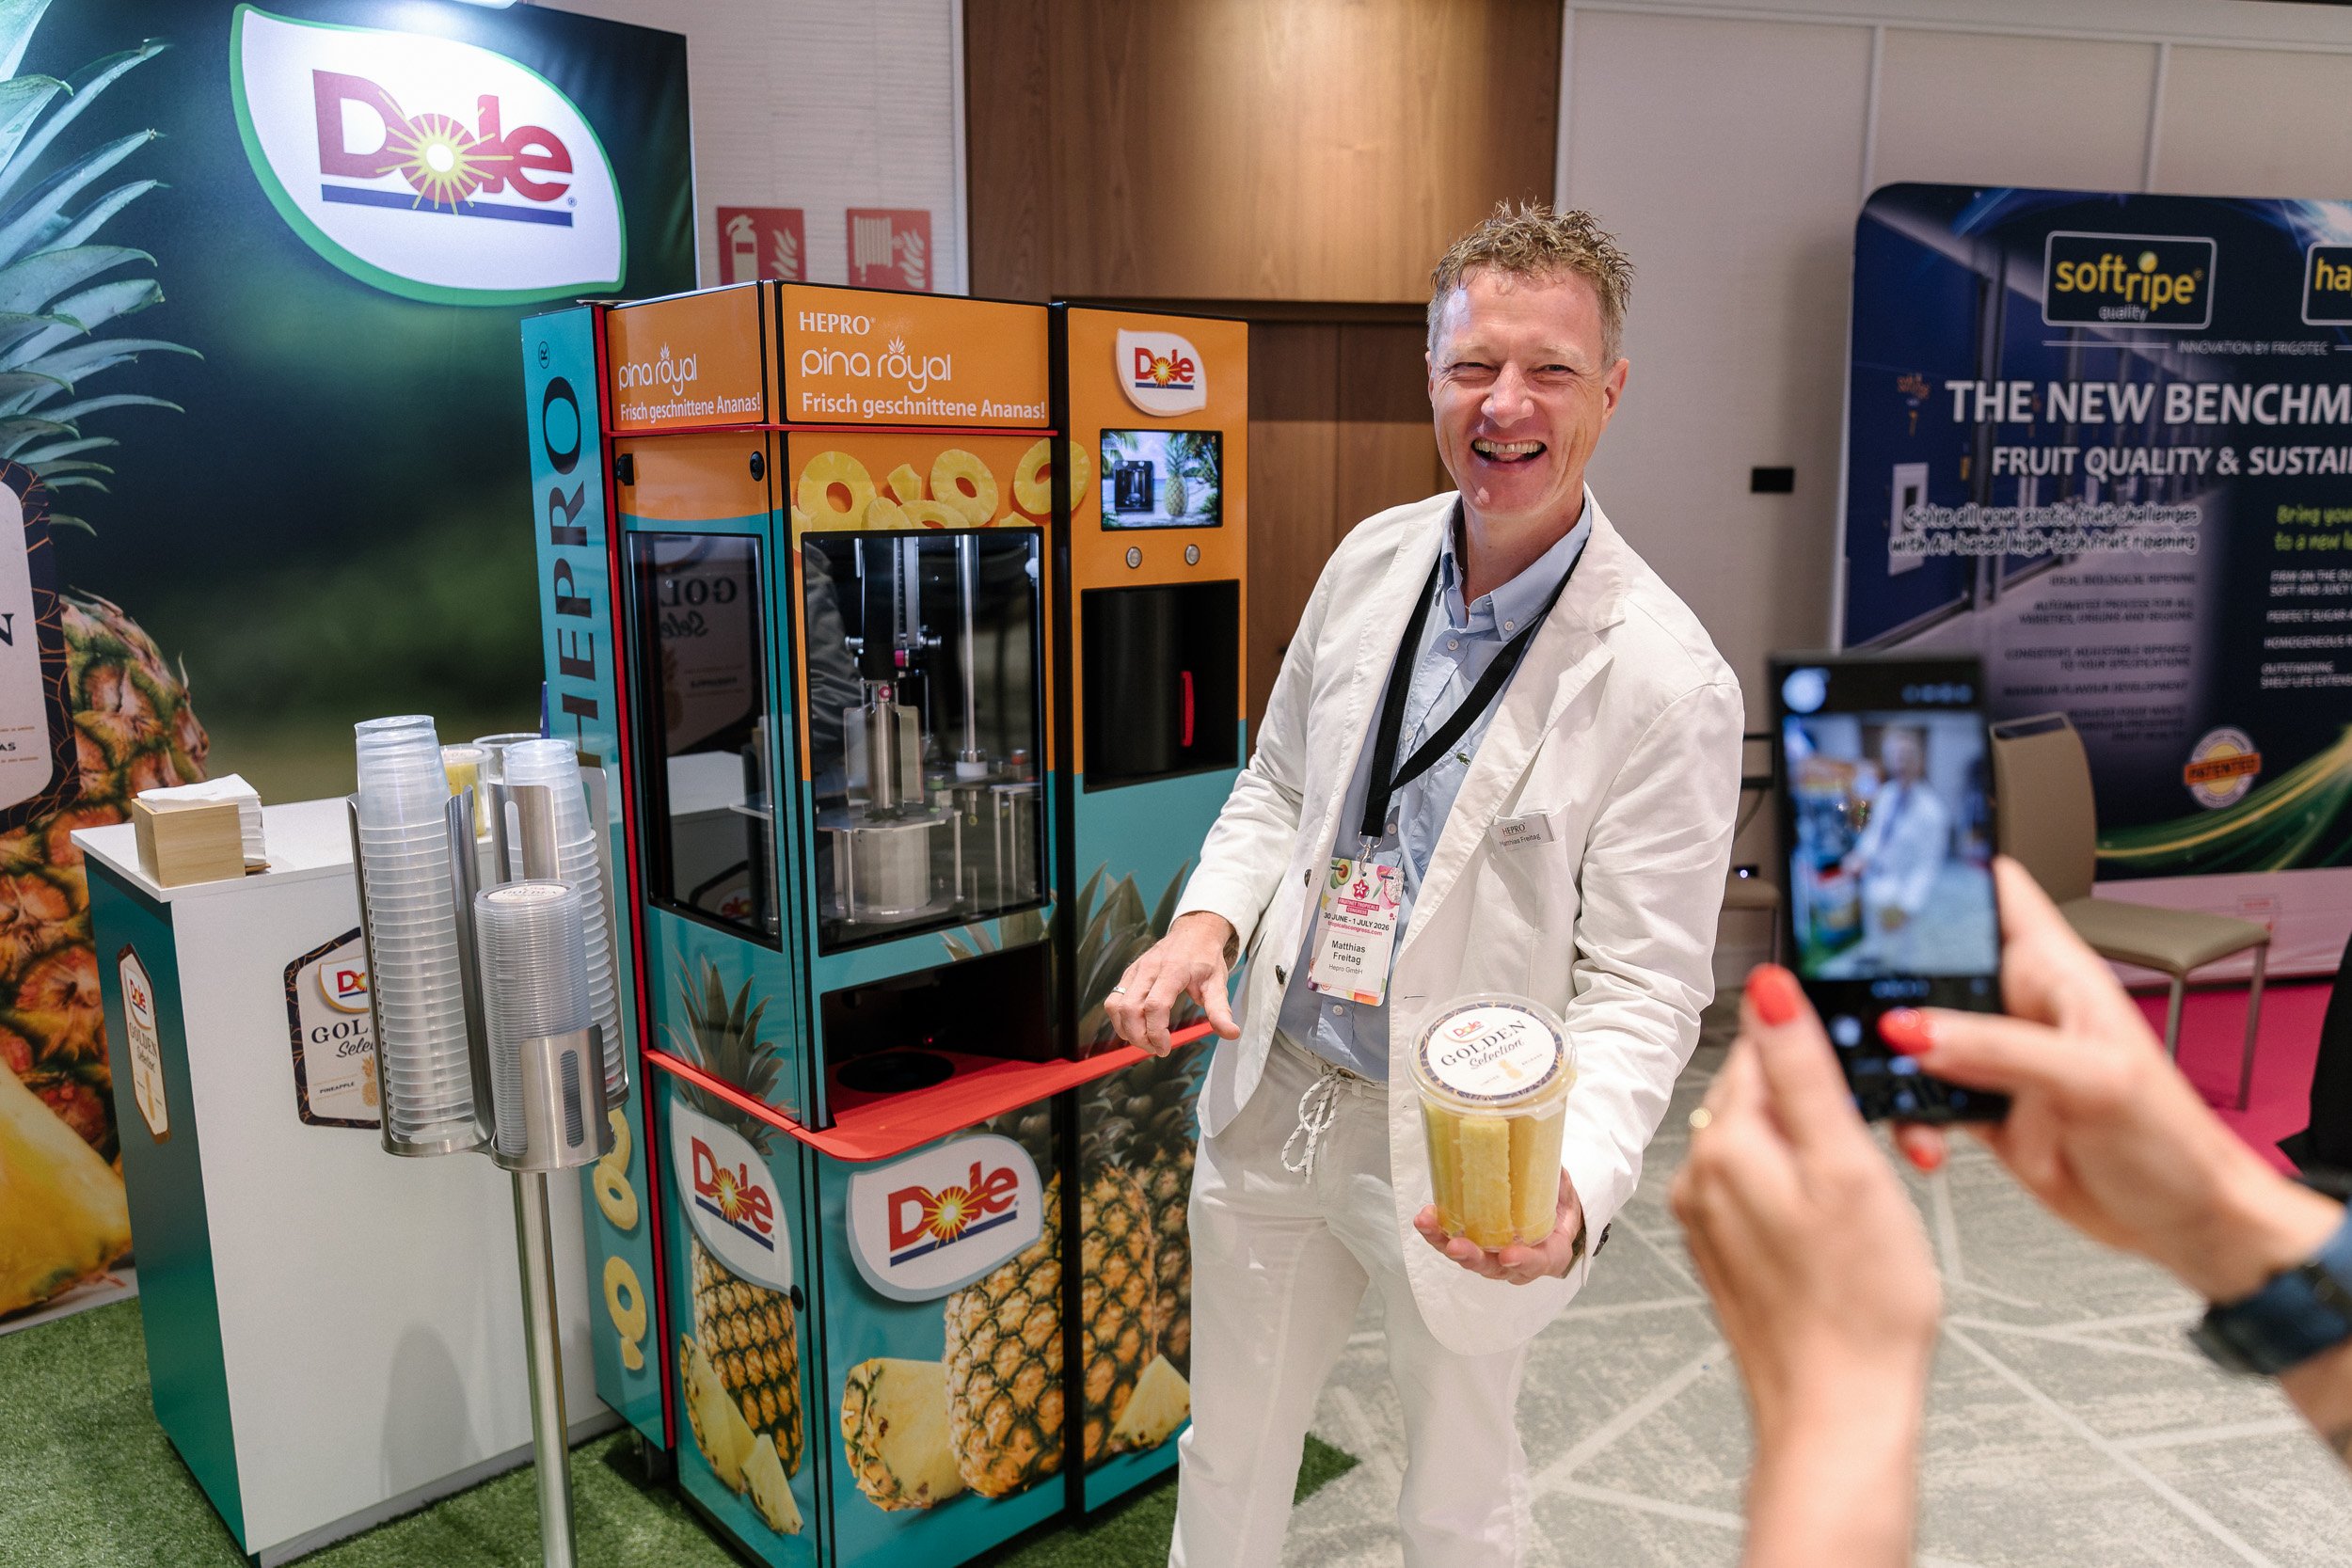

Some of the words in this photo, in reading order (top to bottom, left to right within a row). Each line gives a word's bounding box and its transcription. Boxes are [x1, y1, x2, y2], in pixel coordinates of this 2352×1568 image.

[2055, 251, 2196, 311] softripe
[2098, 304, 2149, 323] quality
[618, 362, 653, 391] pina
[655, 353, 697, 396] royal
[800, 347, 870, 378] pina
[877, 353, 951, 394] royal
[1135, 347, 1195, 385] Dole
[620, 402, 648, 421] Frisch
[649, 398, 714, 423] geschnittene
[716, 391, 761, 415] Ananas!
[803, 392, 857, 414] Frisch
[863, 395, 977, 419] geschnittene
[981, 399, 1046, 420] Ananas!
[1945, 380, 2035, 423] THE
[2046, 381, 2155, 424] NEW
[1992, 446, 2080, 476] FRUIT
[2084, 446, 2212, 484] QUALITY
[2216, 446, 2241, 476] &
[2248, 446, 2352, 476] SUSTAI
[2277, 504, 2321, 527] Bring
[2274, 531, 2294, 551] to
[2309, 533, 2341, 551] new
[1324, 911, 1332, 920] 30
[1332, 913, 1348, 923] JUNE
[1357, 919, 1374, 929] JULY
[1374, 922, 1391, 931] 2026
[1327, 920, 1383, 937] tropicalscongress.com
[1331, 940, 1366, 954] Matthias
[1332, 951, 1361, 965] Freitag
[1328, 963, 1345, 974] Hepro
[1345, 966, 1363, 975] GmbH
[311, 1018, 373, 1044] GOL
[1453, 1021, 1482, 1037] Dole
[1440, 1020, 1527, 1067] GOLDEN
[1470, 1038, 1523, 1070] Selection
[320, 1081, 355, 1094] PINEAPPLE
[691, 1136, 774, 1235] Dole
[888, 1161, 1019, 1253] Dole
